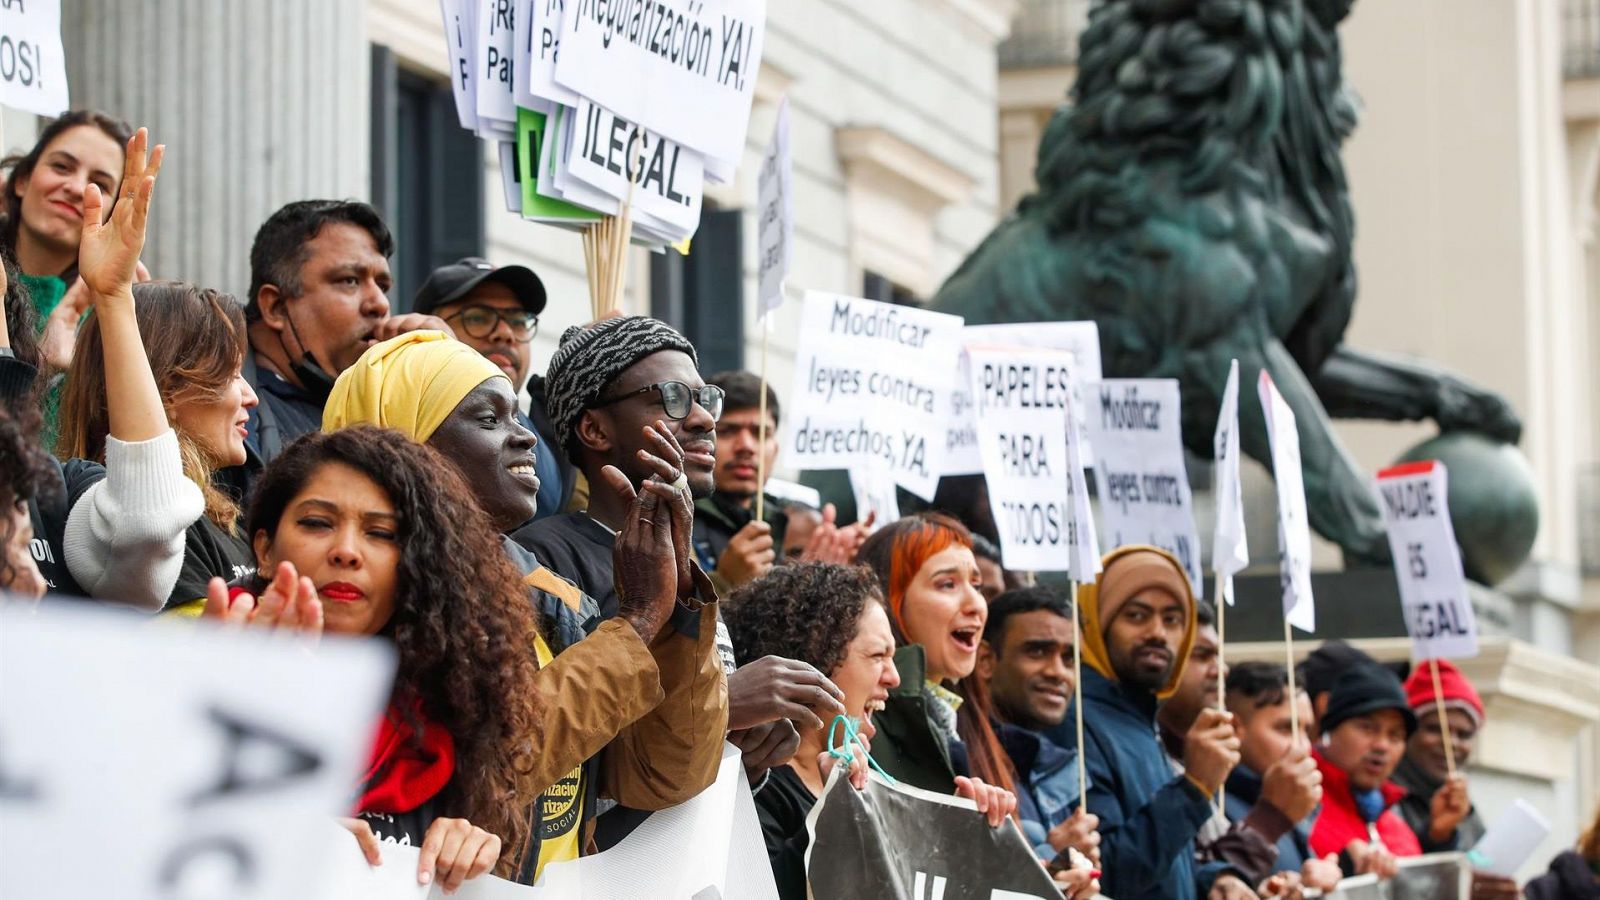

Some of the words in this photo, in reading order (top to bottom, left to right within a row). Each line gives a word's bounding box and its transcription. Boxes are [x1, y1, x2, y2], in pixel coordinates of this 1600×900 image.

[717, 14, 754, 92] YA!
[582, 102, 690, 208] ILEGAL.
[830, 300, 931, 349] Modificar
[808, 355, 862, 404] leyes
[868, 372, 935, 414] contra
[999, 433, 1052, 477] PARA
